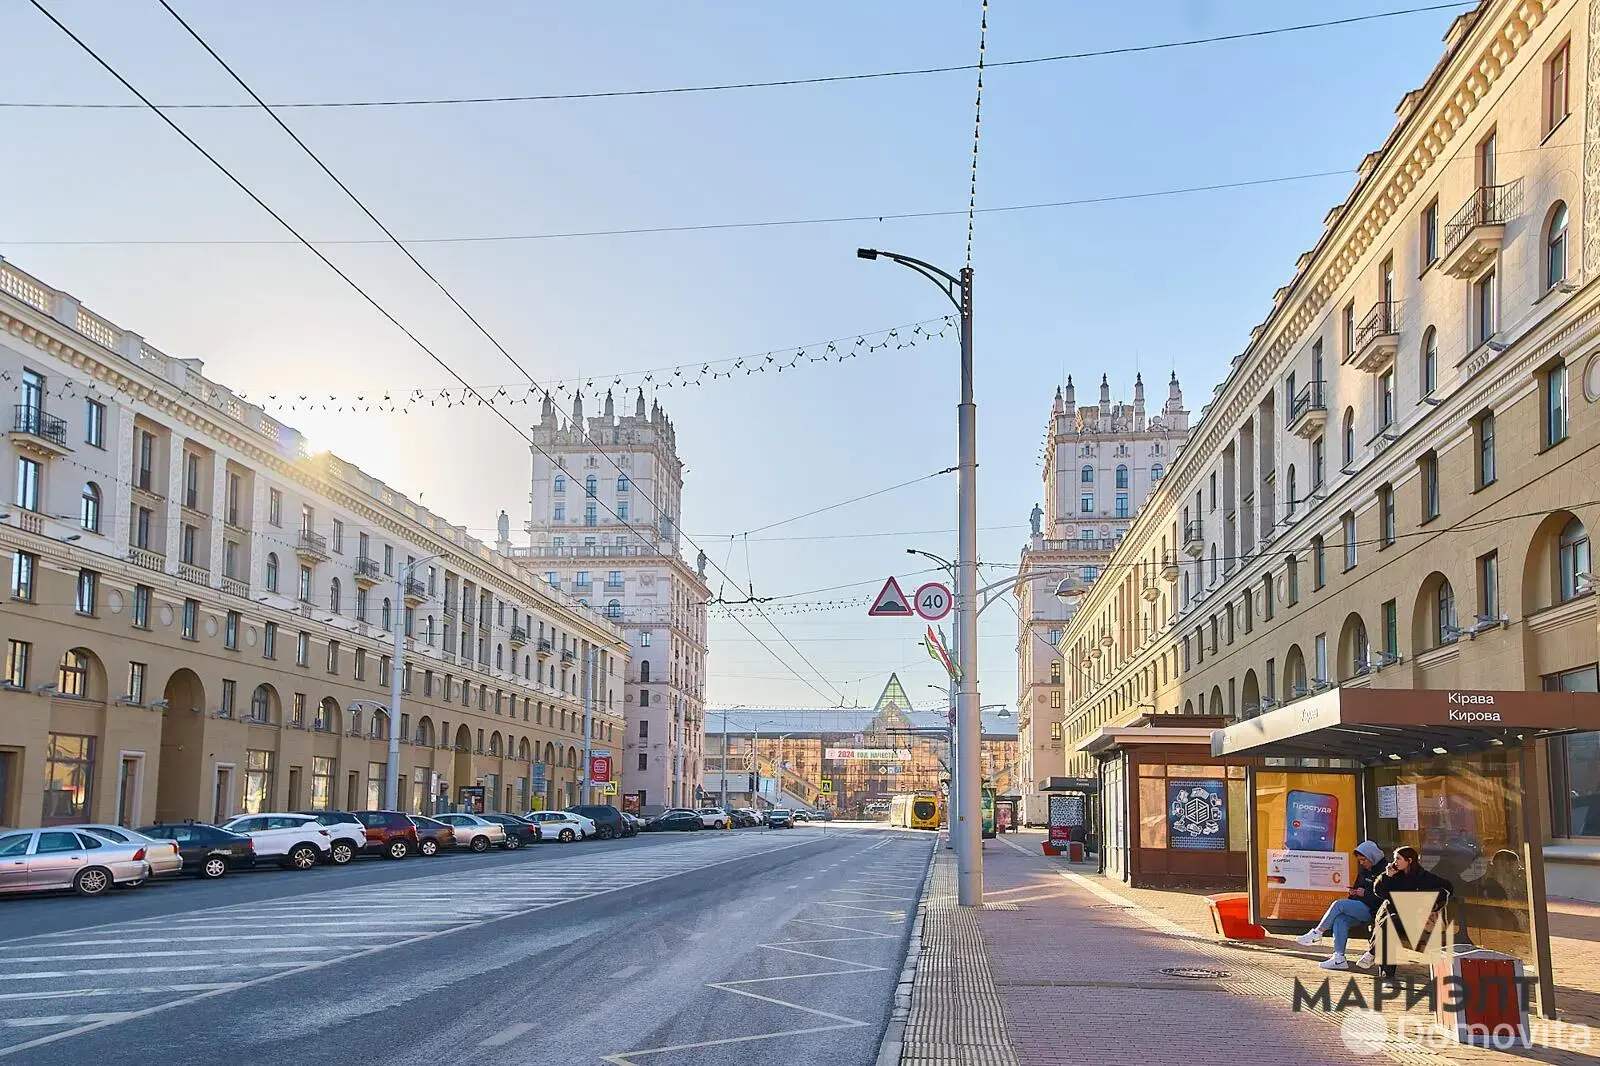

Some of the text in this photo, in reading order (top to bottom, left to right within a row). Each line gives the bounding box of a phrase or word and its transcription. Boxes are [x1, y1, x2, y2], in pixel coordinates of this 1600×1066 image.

[922, 594, 943, 609] 40
[1448, 692, 1494, 706] Кірава
[1449, 709, 1501, 723] Кирова
[1292, 802, 1332, 814] Простуда
